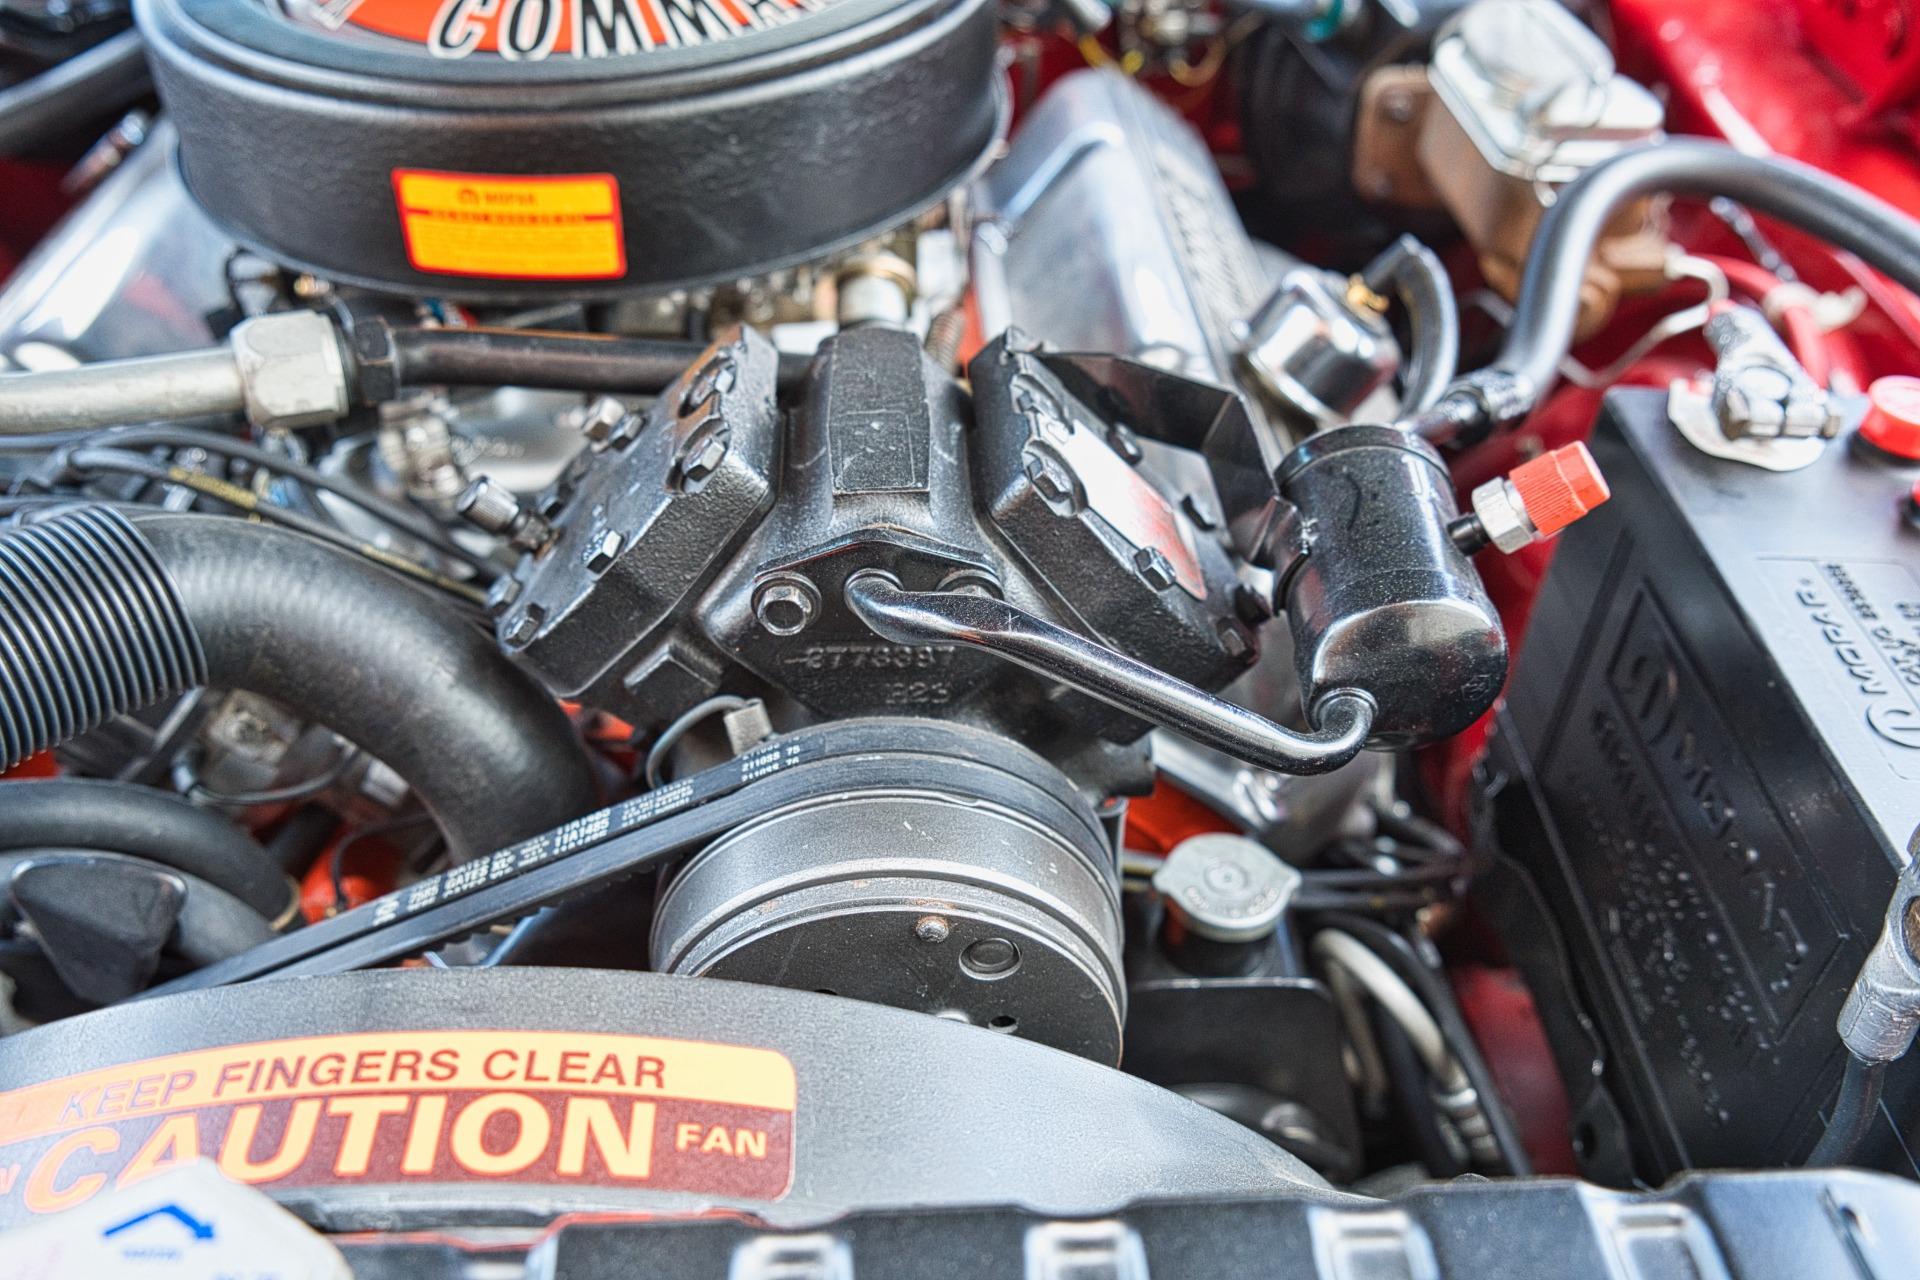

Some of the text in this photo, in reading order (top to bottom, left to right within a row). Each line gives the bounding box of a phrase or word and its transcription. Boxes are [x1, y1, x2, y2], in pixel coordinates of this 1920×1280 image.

[57, 1049, 666, 1126] KEEP FINGERS CLEAR
[24, 1091, 657, 1214] CAUTION
[674, 1122, 769, 1160] FAN
